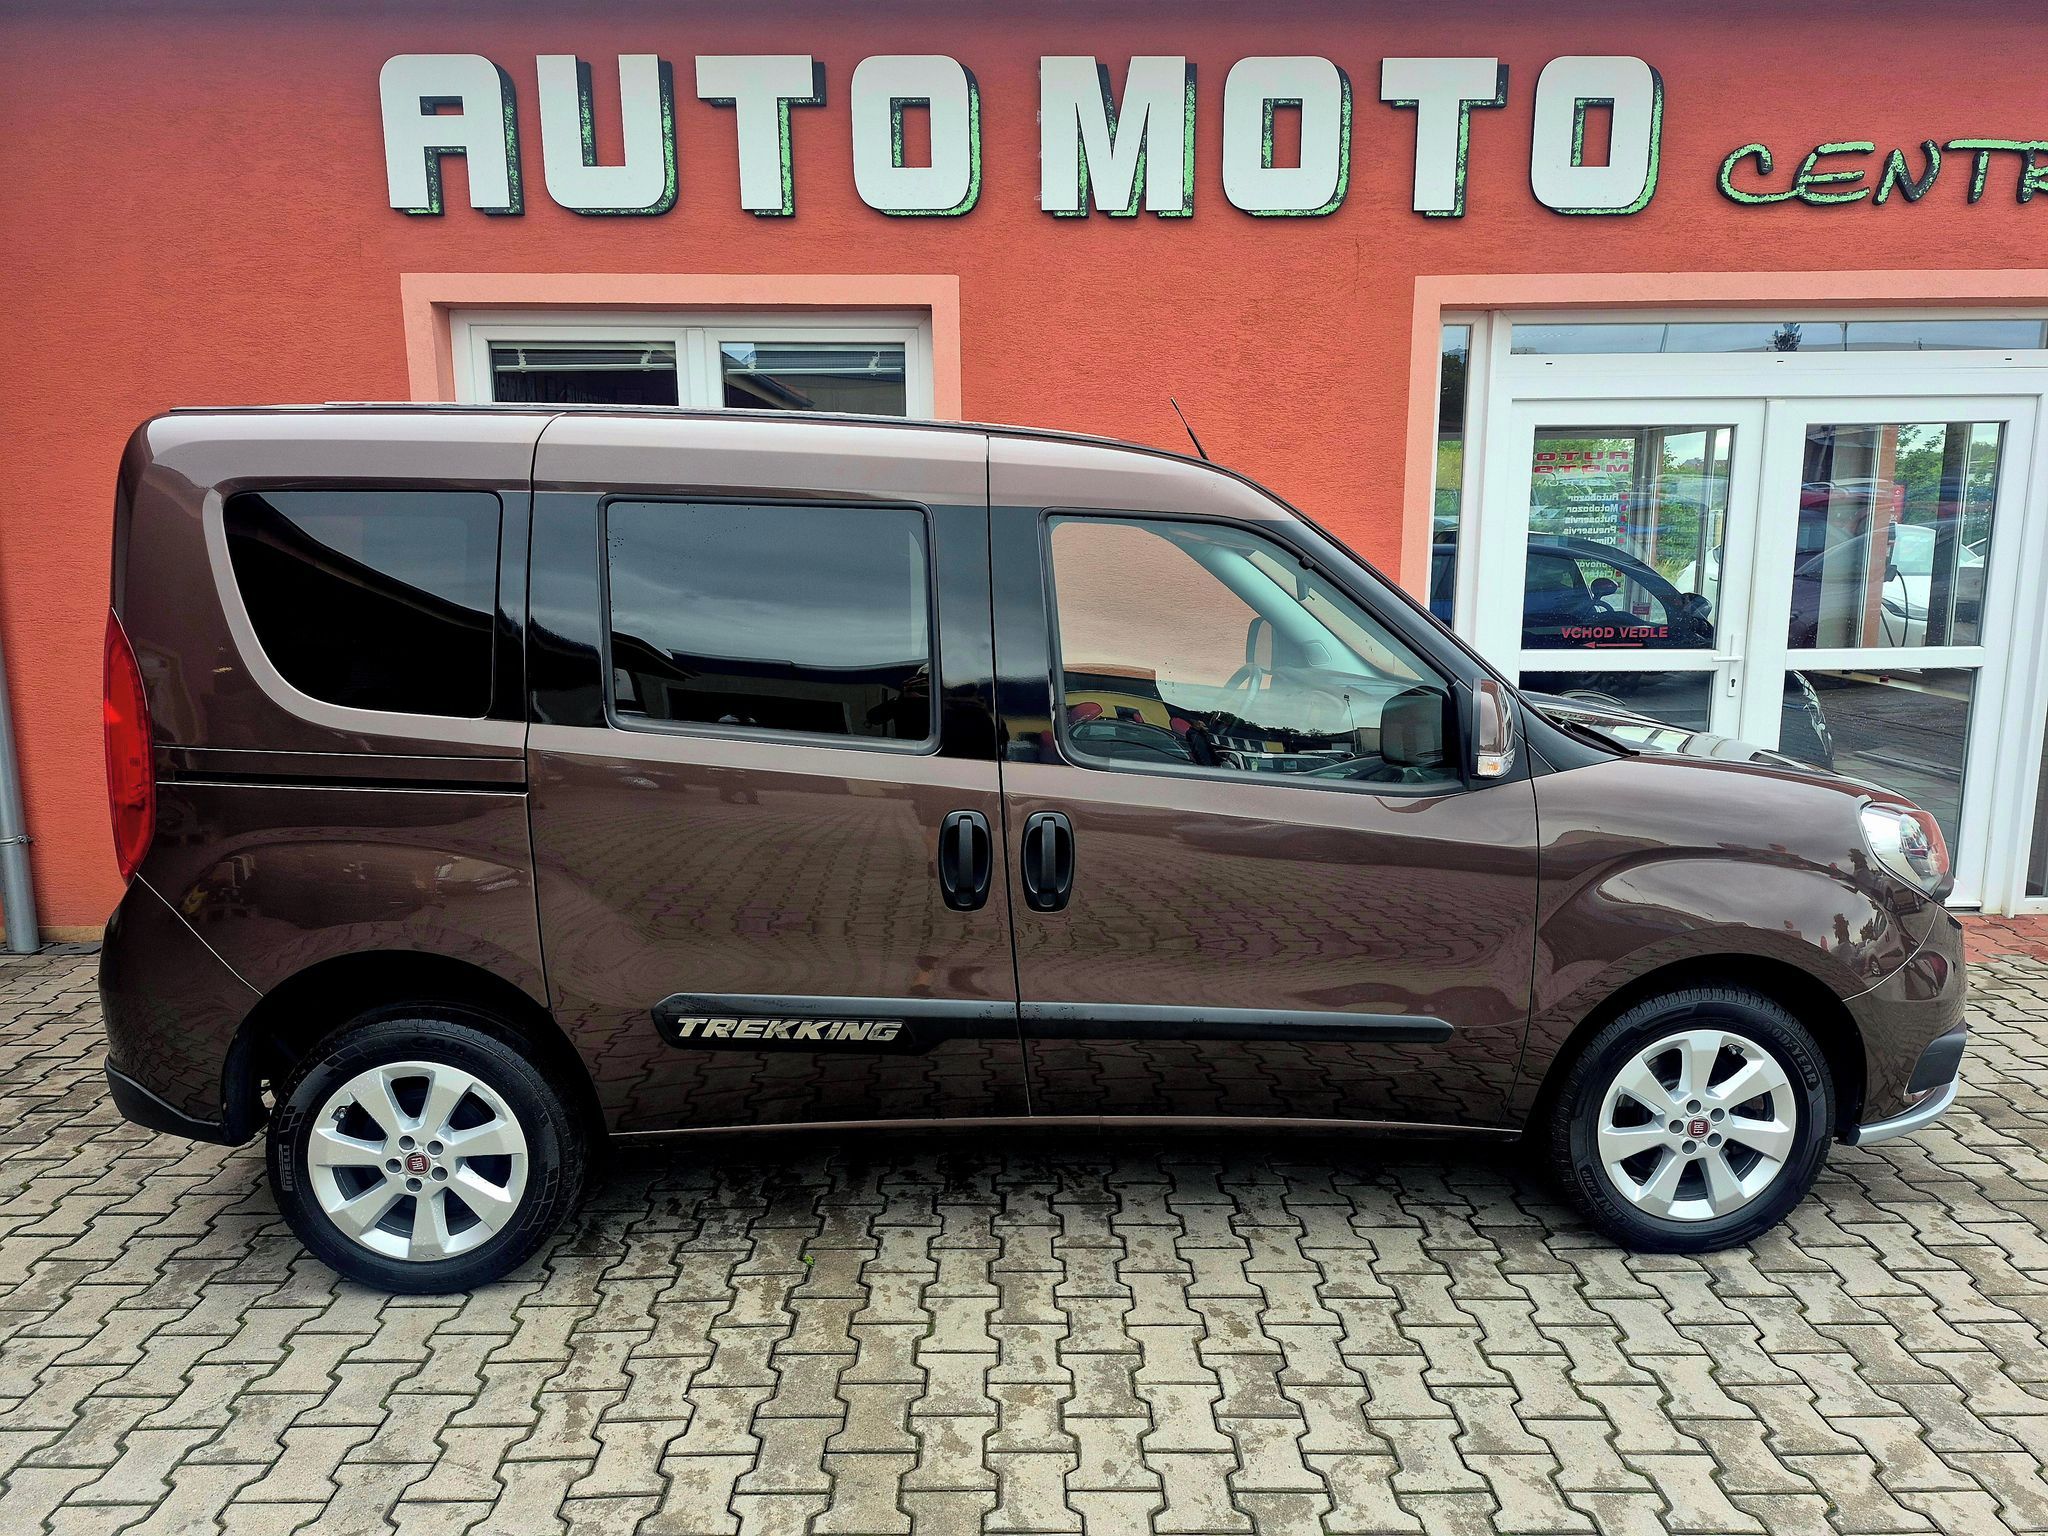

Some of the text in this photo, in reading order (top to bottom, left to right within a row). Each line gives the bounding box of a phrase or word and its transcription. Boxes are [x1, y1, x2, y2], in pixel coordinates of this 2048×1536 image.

[379, 54, 1664, 218] AUTO MOTO
[1561, 626, 1668, 639] VCHOD VEDLE
[677, 1017, 902, 1041] TREKKING
[278, 1143, 294, 1192] PIRELLI
[411, 1157, 424, 1171] FIAT
